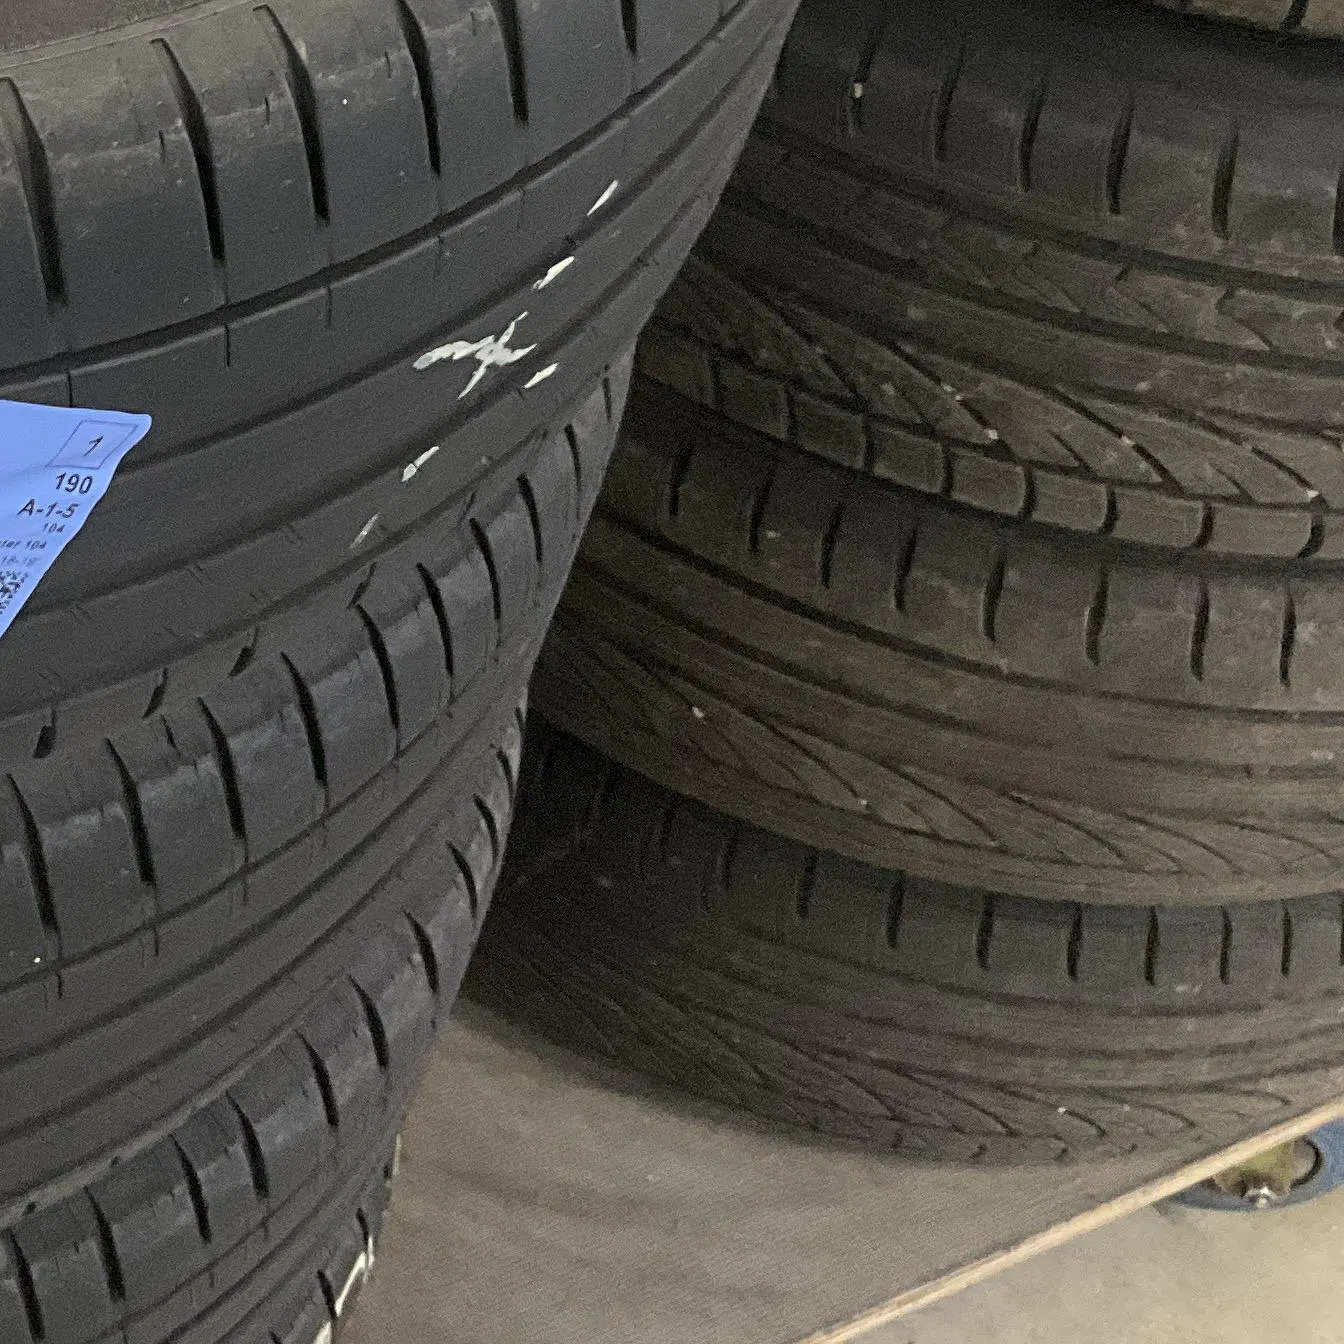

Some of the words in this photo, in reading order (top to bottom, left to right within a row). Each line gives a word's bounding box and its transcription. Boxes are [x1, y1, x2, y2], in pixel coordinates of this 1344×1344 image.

[83, 435, 104, 457] 1
[55, 471, 94, 494] 190
[17, 498, 79, 519] A-1-5
